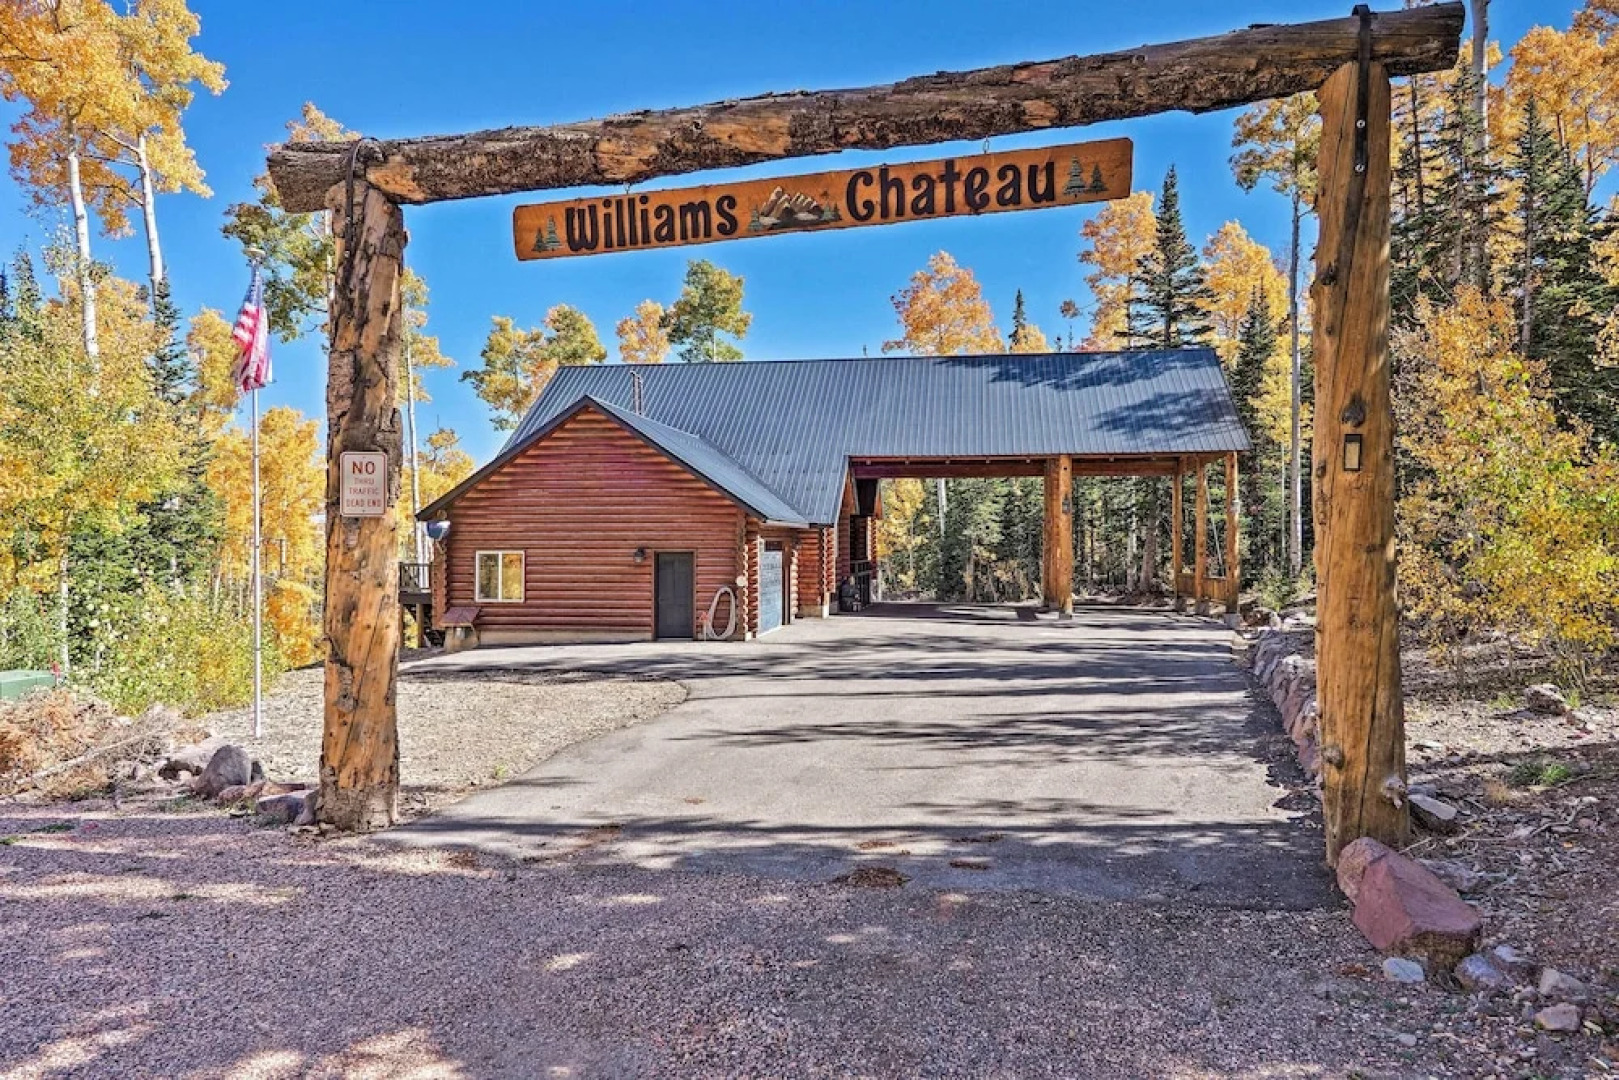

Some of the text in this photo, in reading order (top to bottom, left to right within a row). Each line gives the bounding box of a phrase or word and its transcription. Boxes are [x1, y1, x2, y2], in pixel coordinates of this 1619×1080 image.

[565, 159, 1055, 251] Williams Chateau
[352, 461, 375, 475] NO
[349, 487, 379, 495] TRAFFIC
[346, 499, 382, 507] DEAD END
